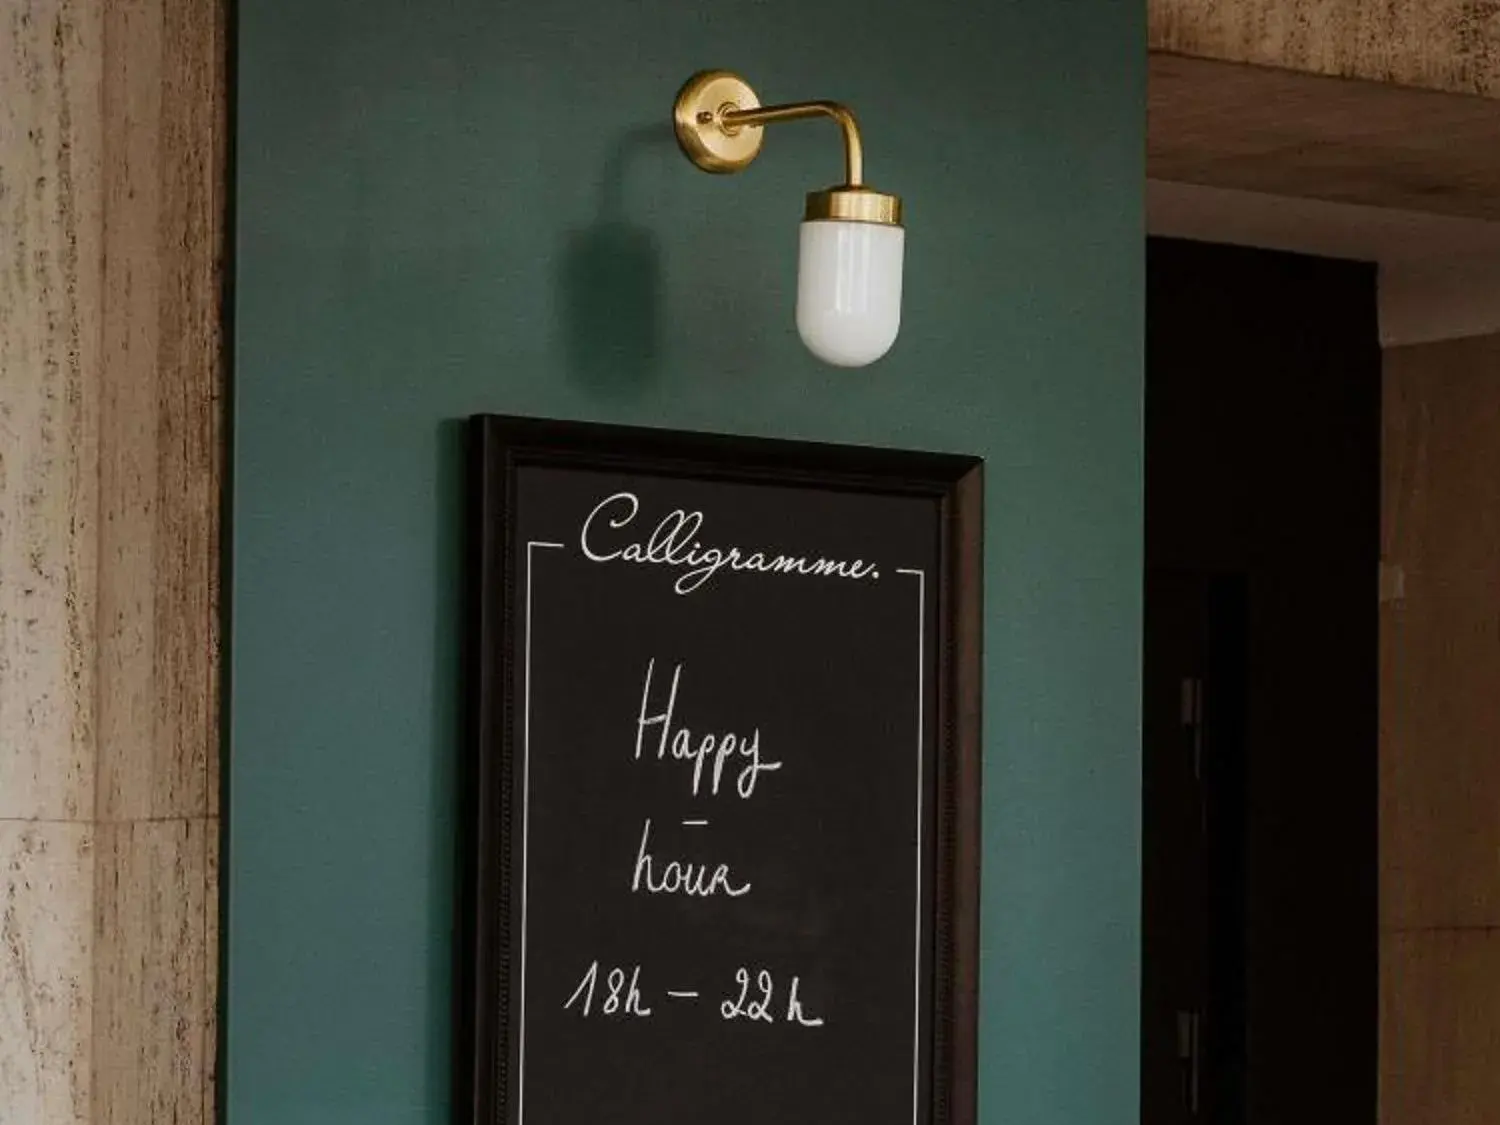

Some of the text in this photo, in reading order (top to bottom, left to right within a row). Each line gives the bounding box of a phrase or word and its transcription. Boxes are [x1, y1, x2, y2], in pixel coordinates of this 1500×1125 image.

[581, 492, 879, 594] Calligramme.
[635, 658, 782, 798] Happy
[632, 819, 751, 896] hour
[564, 960, 651, 1016] 18h
